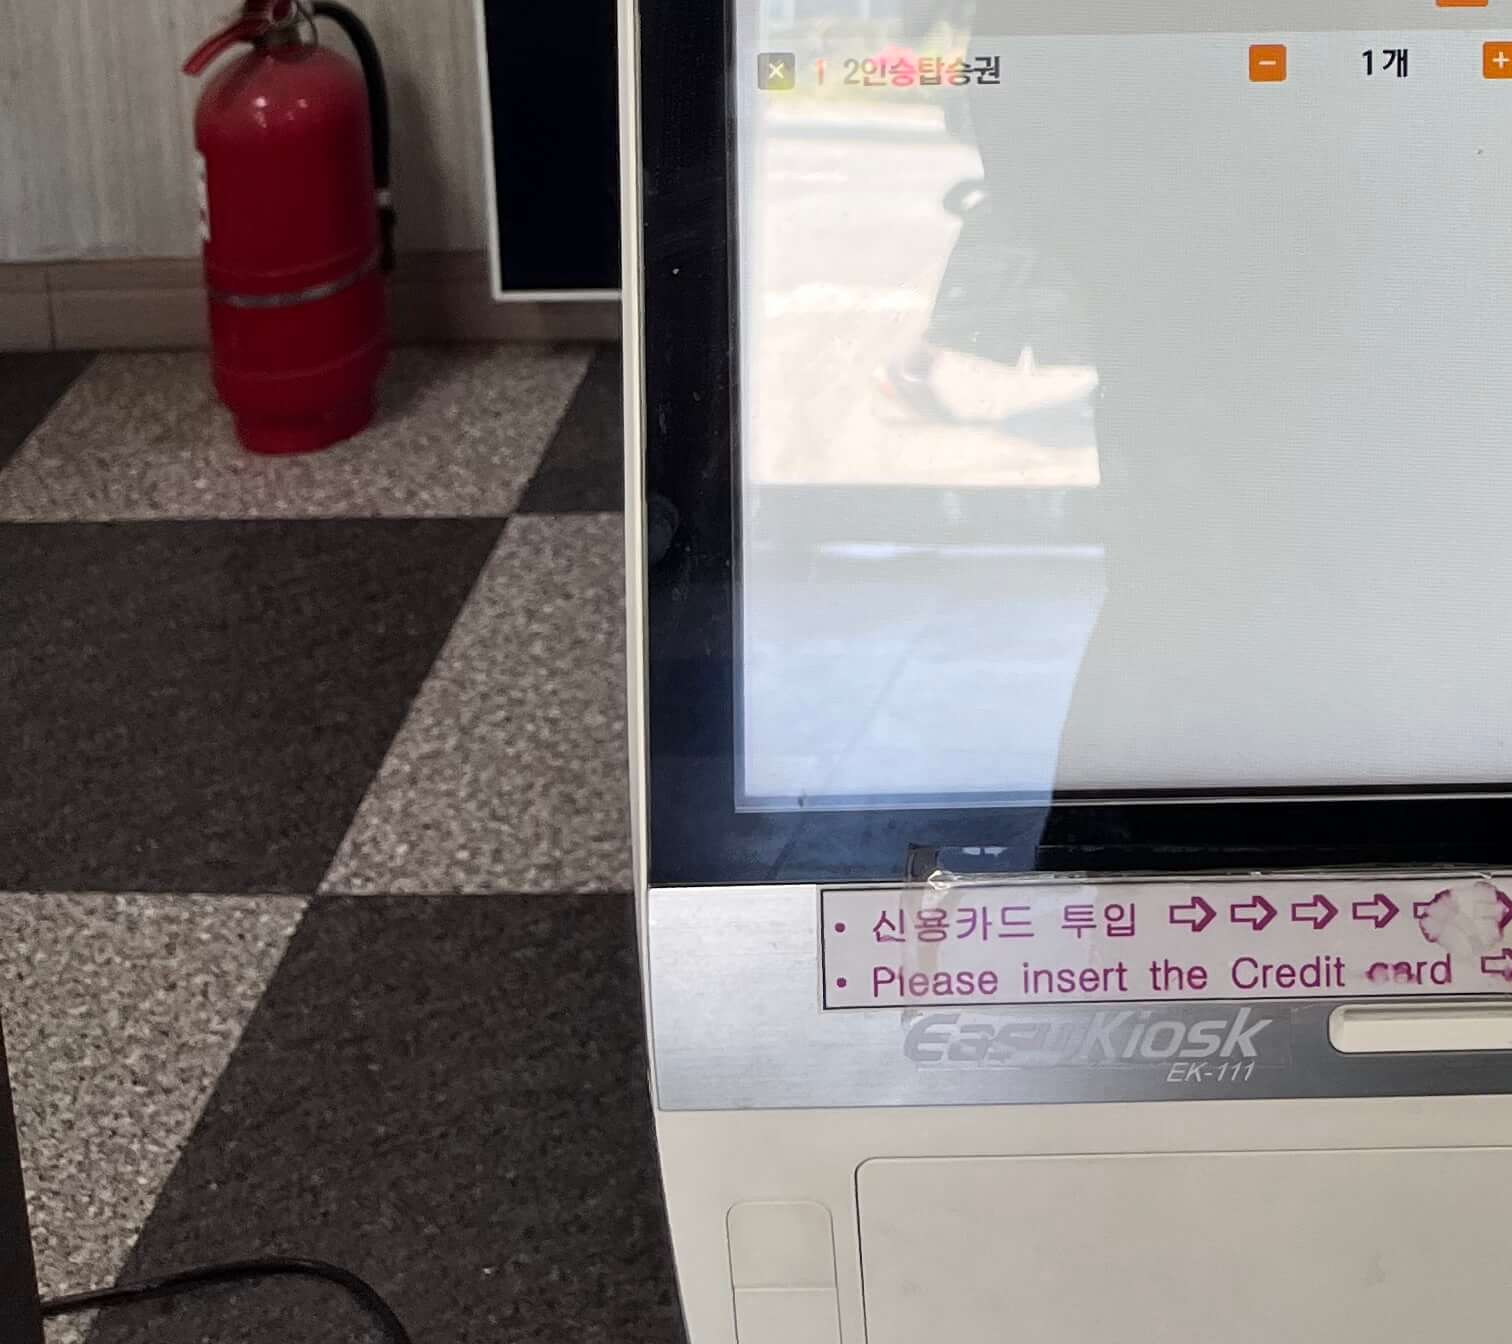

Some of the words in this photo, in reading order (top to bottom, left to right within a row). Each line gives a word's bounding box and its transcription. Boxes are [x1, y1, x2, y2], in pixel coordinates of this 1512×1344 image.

[843, 56, 1001, 87] 2인승탑승권
[872, 904, 1035, 944] 신용카드
[1060, 902, 1137, 939] 투입
[873, 965, 999, 998] Please
[1022, 961, 1128, 994] insert
[1150, 959, 1208, 991] the
[1231, 955, 1346, 989] Credit
[1365, 952, 1453, 985] card
[1166, 1061, 1256, 1083] EK-111
